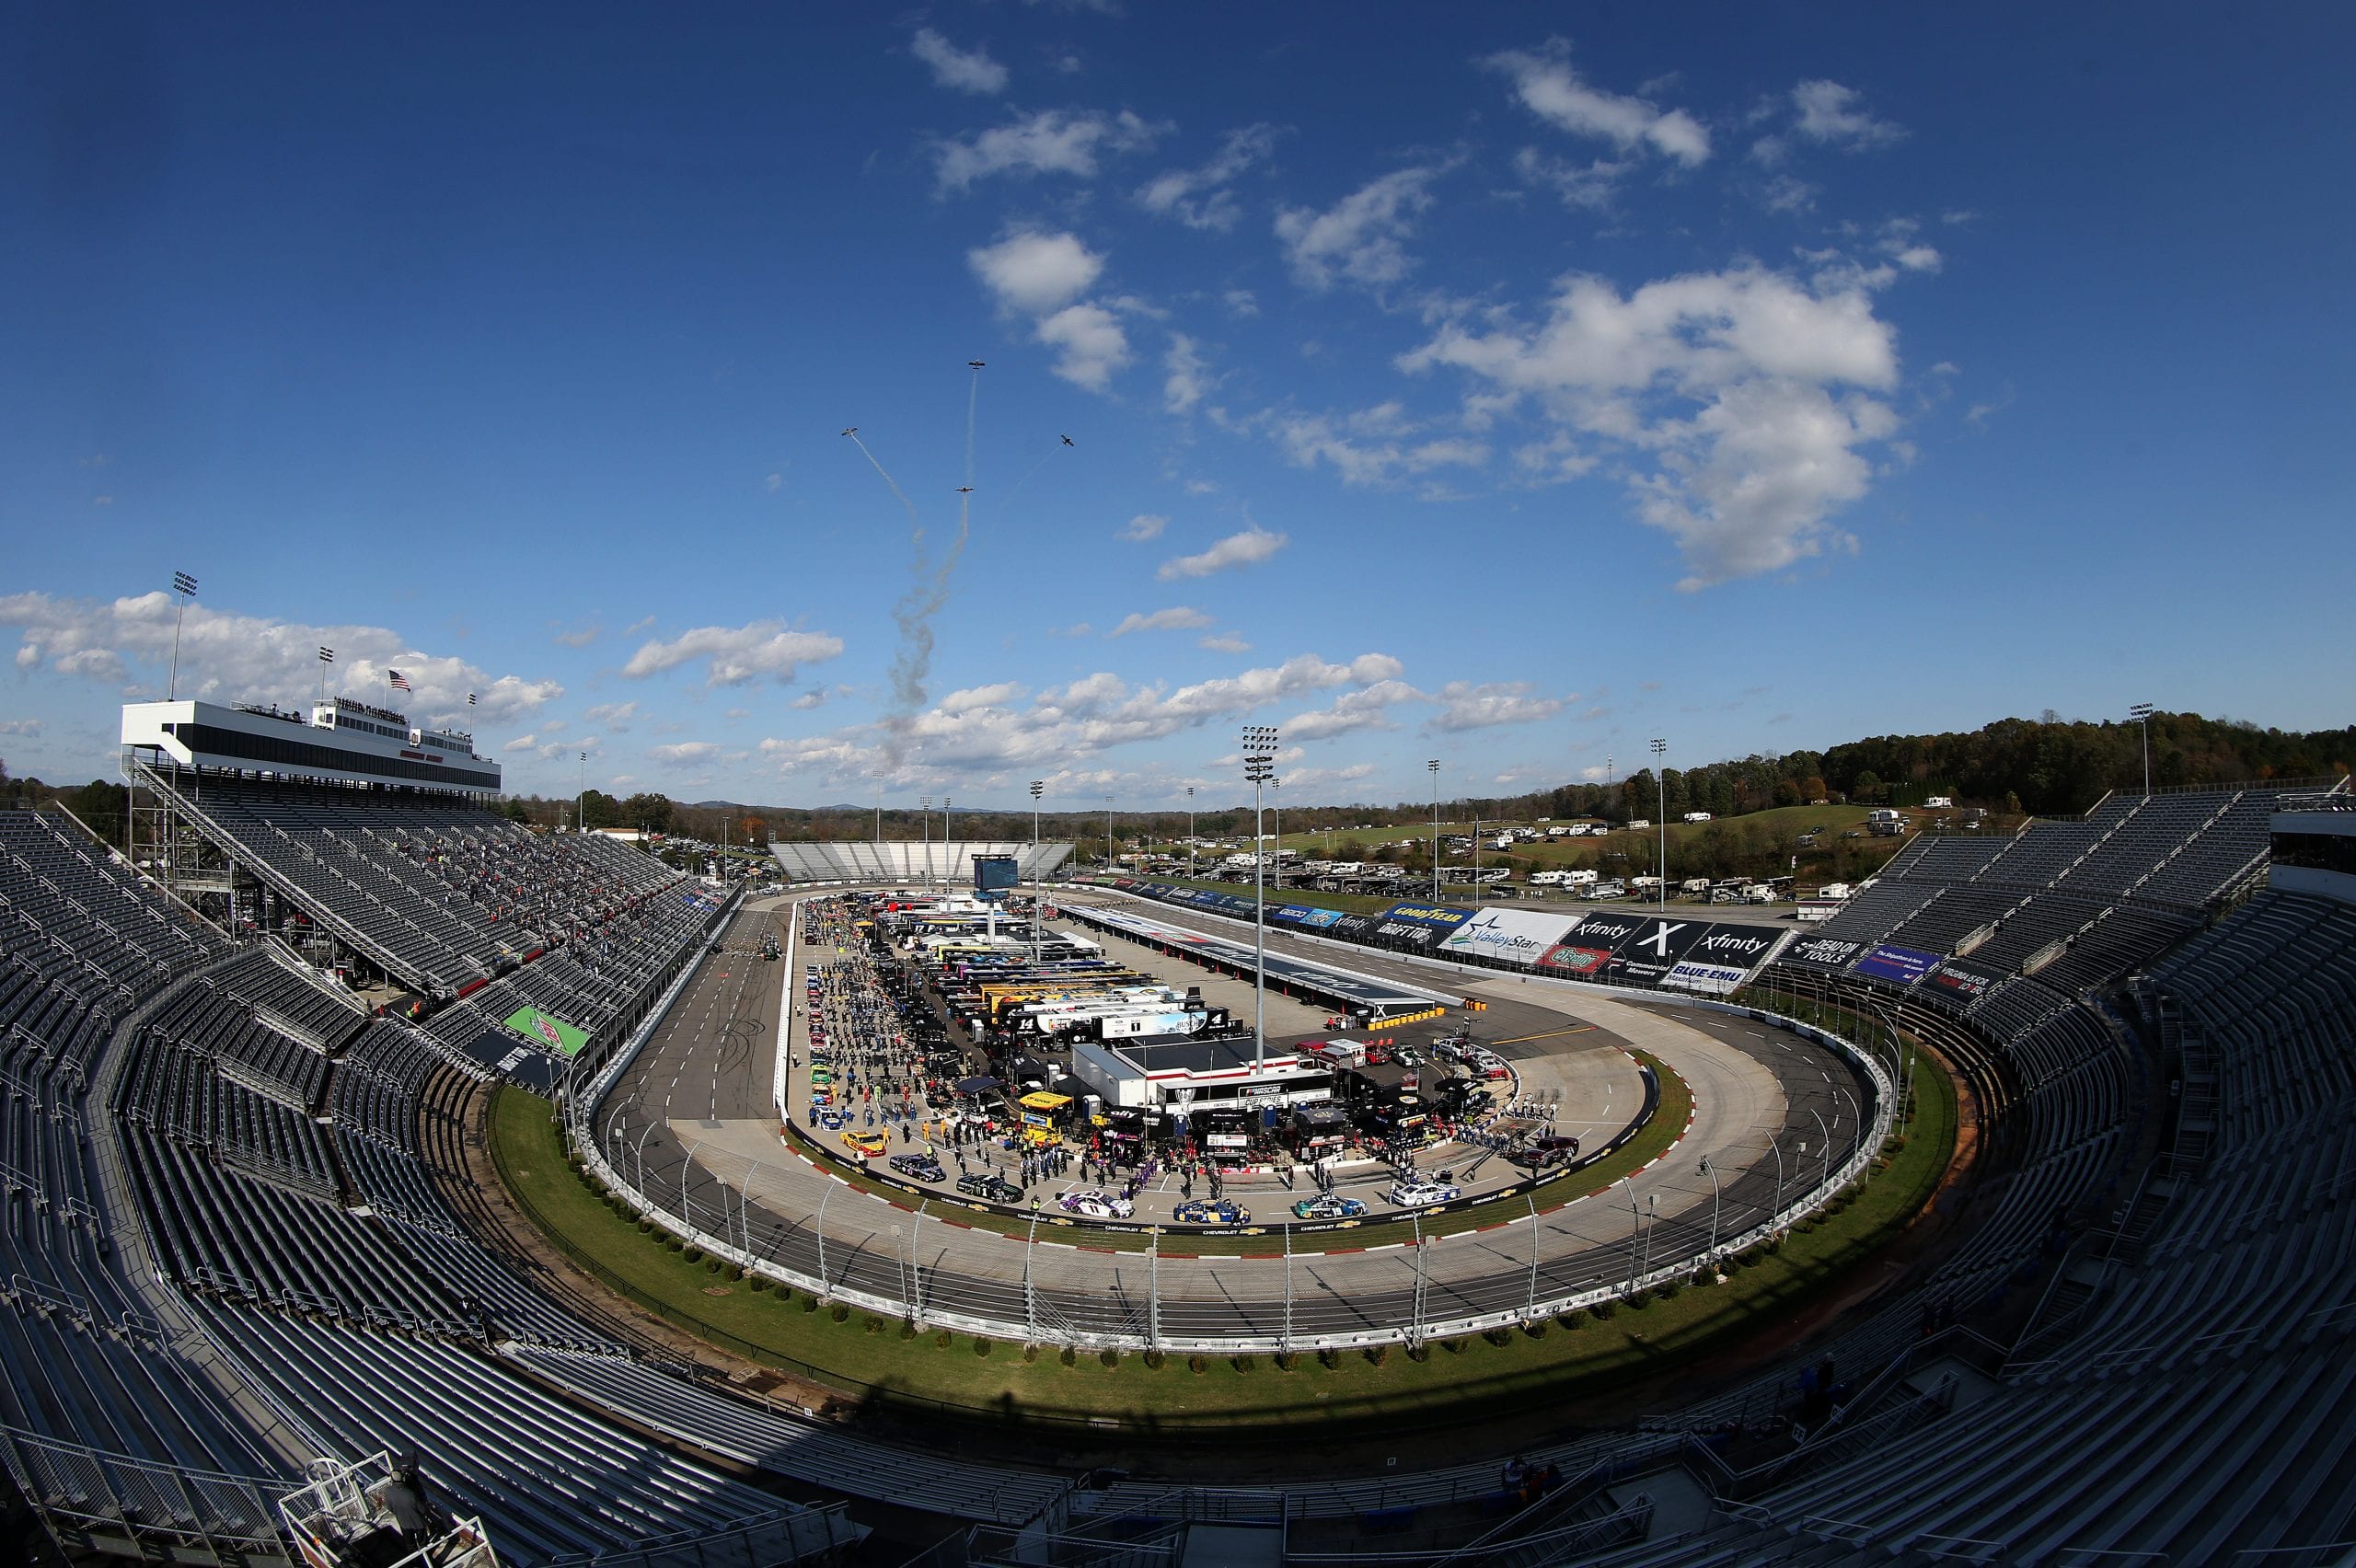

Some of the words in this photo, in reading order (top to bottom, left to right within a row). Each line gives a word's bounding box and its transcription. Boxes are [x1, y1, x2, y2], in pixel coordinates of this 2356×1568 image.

[1279, 908, 1307, 917] GEICO
[1393, 907, 1463, 923] GOODYEAR
[1334, 916, 1369, 930] xfinity
[1576, 921, 1632, 939] xfinity
[1636, 922, 1688, 956] X
[1701, 934, 1769, 954] xfinity
[1814, 939, 1843, 952] DEAD
[1841, 942, 1860, 953] ON
[1803, 951, 1846, 963] TOOLS
[1626, 961, 1669, 972] Commercial
[1626, 967, 1656, 976] Mowers
[1377, 1005, 1387, 1017] X
[1211, 1013, 1222, 1024] 4
[1019, 1019, 1034, 1030] 14
[1253, 1086, 1280, 1095] NASCAR
[1245, 1098, 1259, 1106] CUP
[1110, 1110, 1138, 1118] ally
[1103, 1130, 1118, 1139] ally
[982, 1187, 987, 1196] 1
[941, 1197, 967, 1207] CHEVROLET
[1472, 1195, 1497, 1205] CHEVROLET
[1089, 1205, 1099, 1214] 11
[1332, 1206, 1343, 1216] 19
[1105, 1225, 1138, 1233] CHEVROLET
